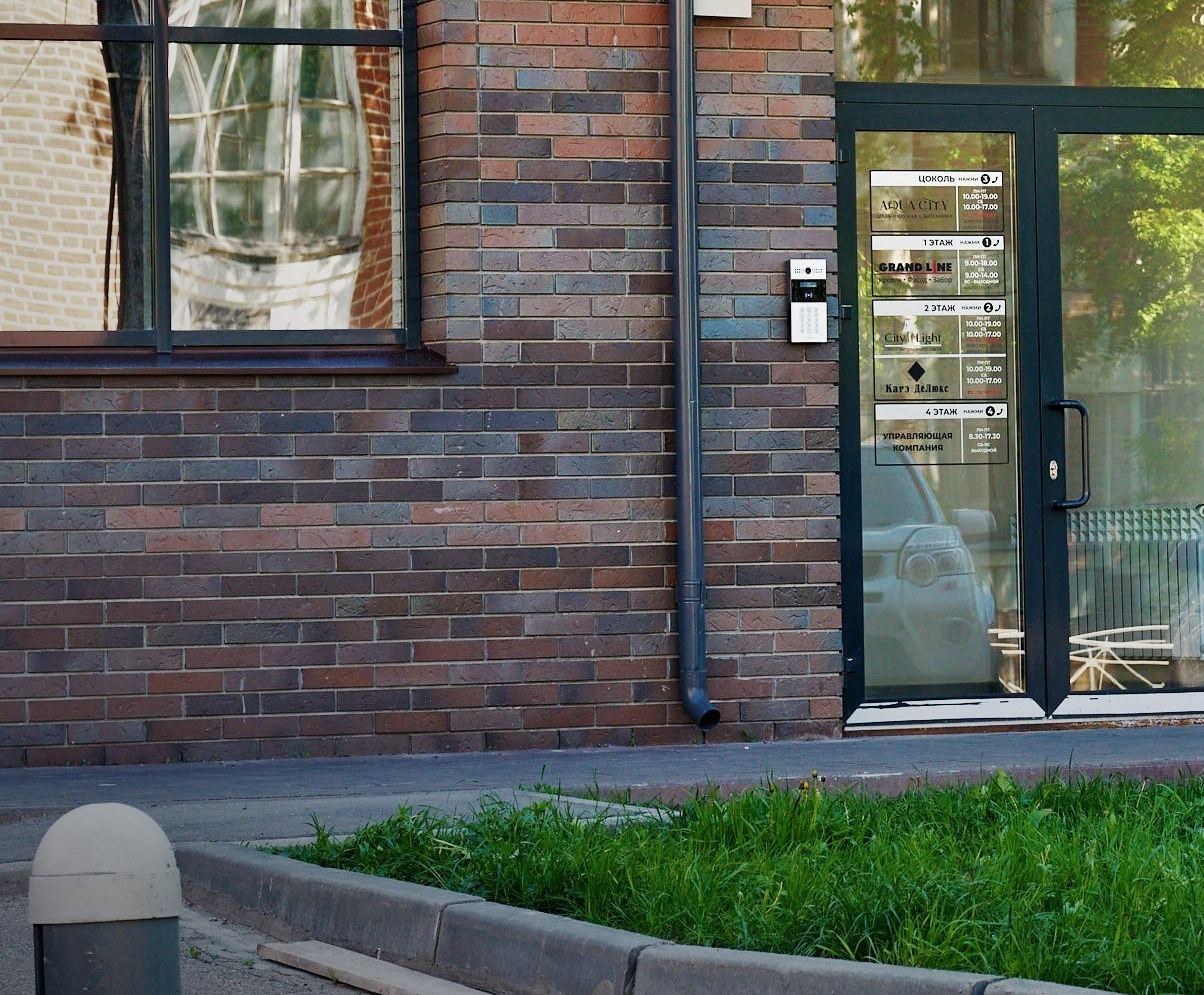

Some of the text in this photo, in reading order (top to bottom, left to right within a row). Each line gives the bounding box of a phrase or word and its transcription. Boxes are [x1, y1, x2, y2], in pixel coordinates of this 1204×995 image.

[918, 175, 955, 183] ЦОКОЛЬ
[879, 259, 953, 274] GRAND LINE
[931, 304, 956, 312] ЭТАЖ
[884, 332, 942, 344] City Light
[883, 432, 953, 440] УПРАВЛЯЮЩАЯ
[893, 444, 944, 452] КОМПАНИЯ
